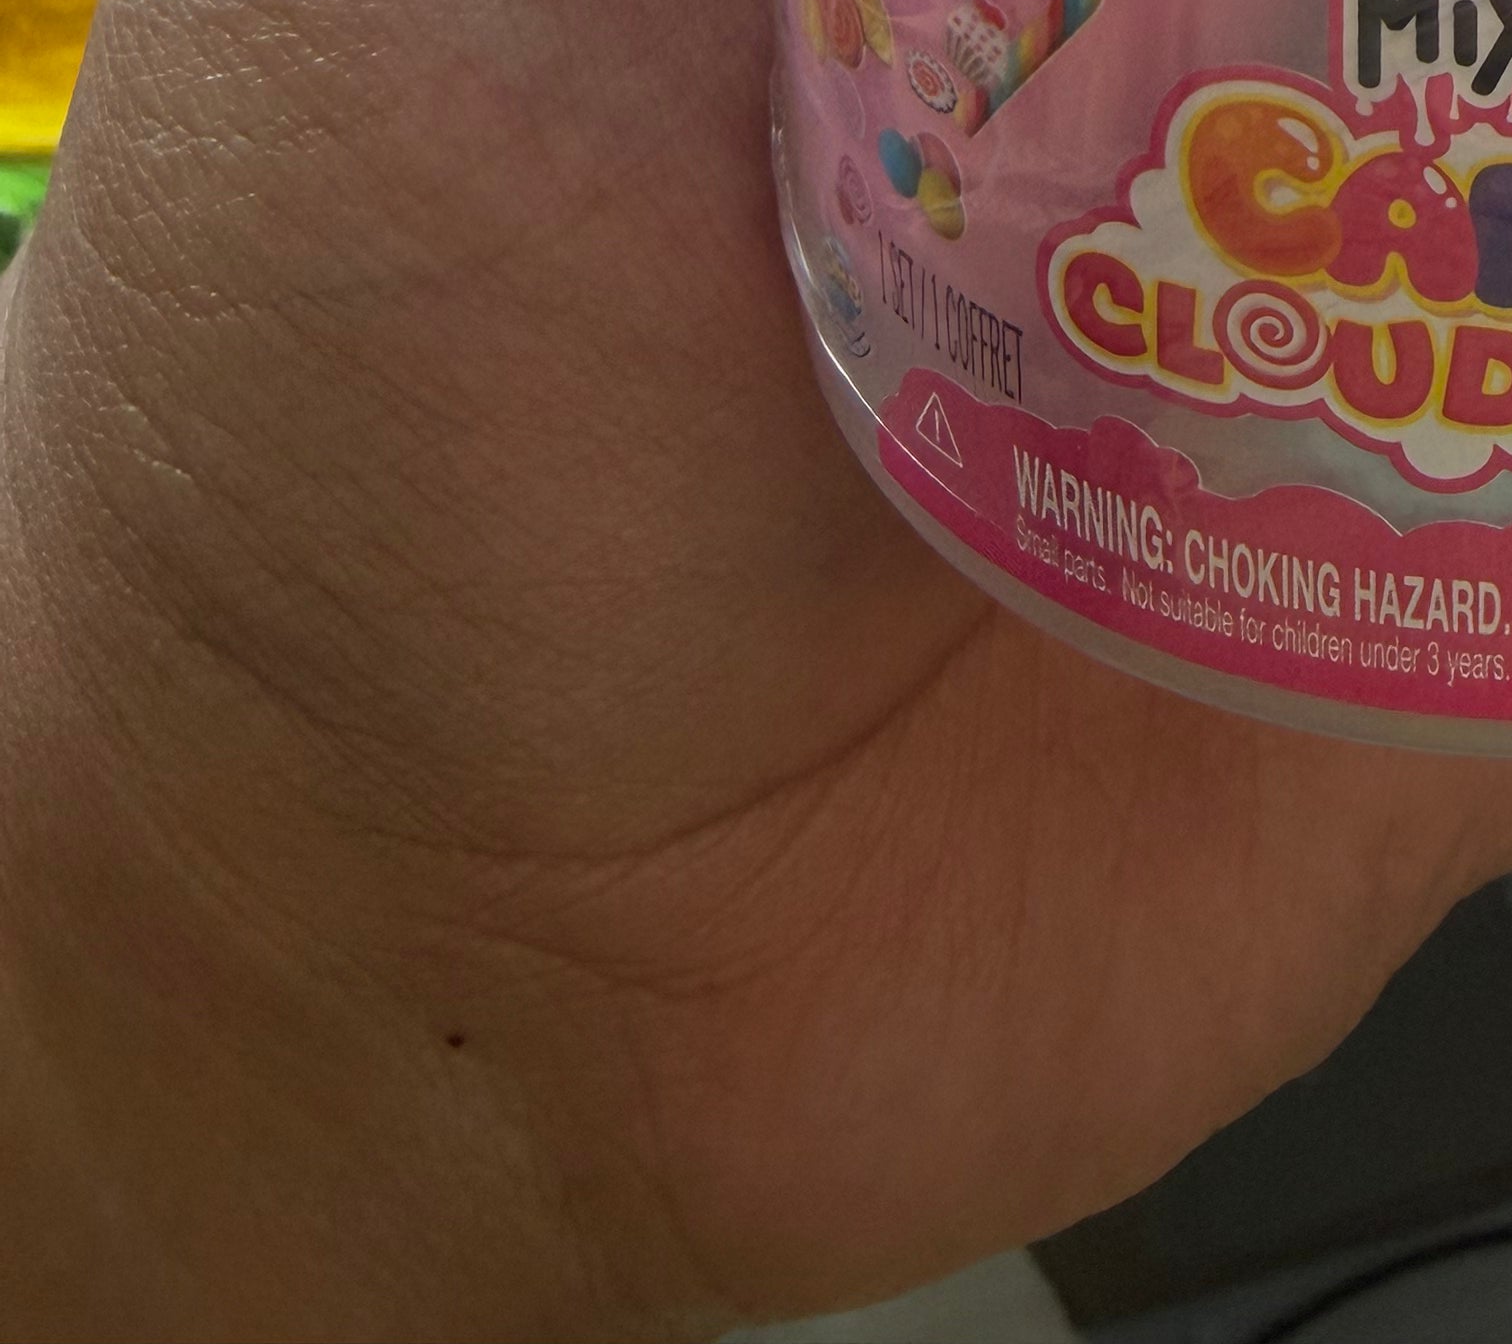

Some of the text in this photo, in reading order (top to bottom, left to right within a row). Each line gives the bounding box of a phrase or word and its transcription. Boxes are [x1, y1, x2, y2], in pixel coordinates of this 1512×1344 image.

[877, 229, 887, 305] 1
[889, 240, 916, 331] SET
[931, 274, 940, 350] 1
[946, 284, 1024, 405] COFFRET
[1013, 443, 1511, 636] WARNING: CHOKING HAZARD.
[1016, 513, 1511, 688] Small parts. Not suitable for children under 3 years.
